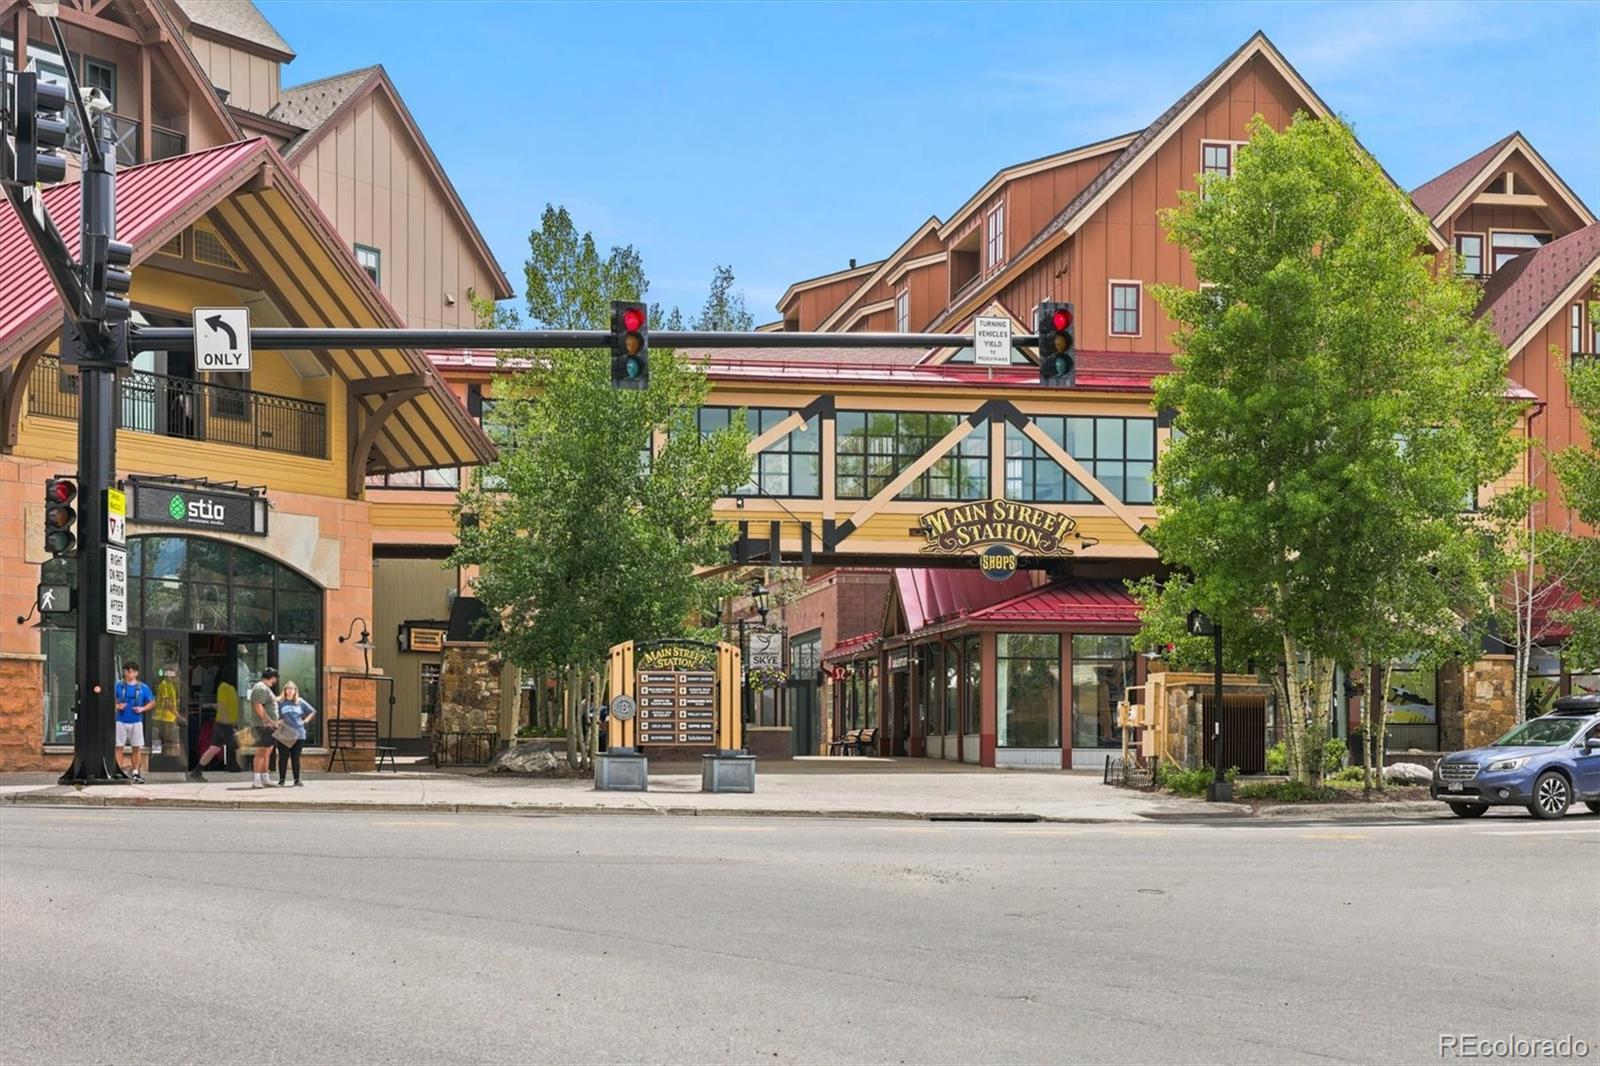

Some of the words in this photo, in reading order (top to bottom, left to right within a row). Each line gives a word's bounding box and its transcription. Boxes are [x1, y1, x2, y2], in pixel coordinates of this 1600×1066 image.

[979, 320, 1007, 328] TURNING
[978, 329, 1008, 338] VEHICLES
[983, 340, 1003, 348] YIELD
[204, 353, 242, 366] ONLY
[188, 499, 225, 520] stio
[926, 503, 986, 537] MAIN
[992, 500, 1075, 540] STREET
[956, 523, 1043, 547] STATION
[110, 553, 123, 566] RIGHT
[982, 555, 1015, 571] SHOPS
[109, 568, 115, 579] ON
[116, 569, 124, 582] RED
[110, 584, 124, 596] ARROW
[110, 599, 123, 611] AFTER
[111, 614, 122, 626] STOP
[645, 648, 672, 664] MAIN
[672, 647, 707, 665] STREET
[753, 656, 778, 665] SKYE
[656, 657, 696, 668] STATION
